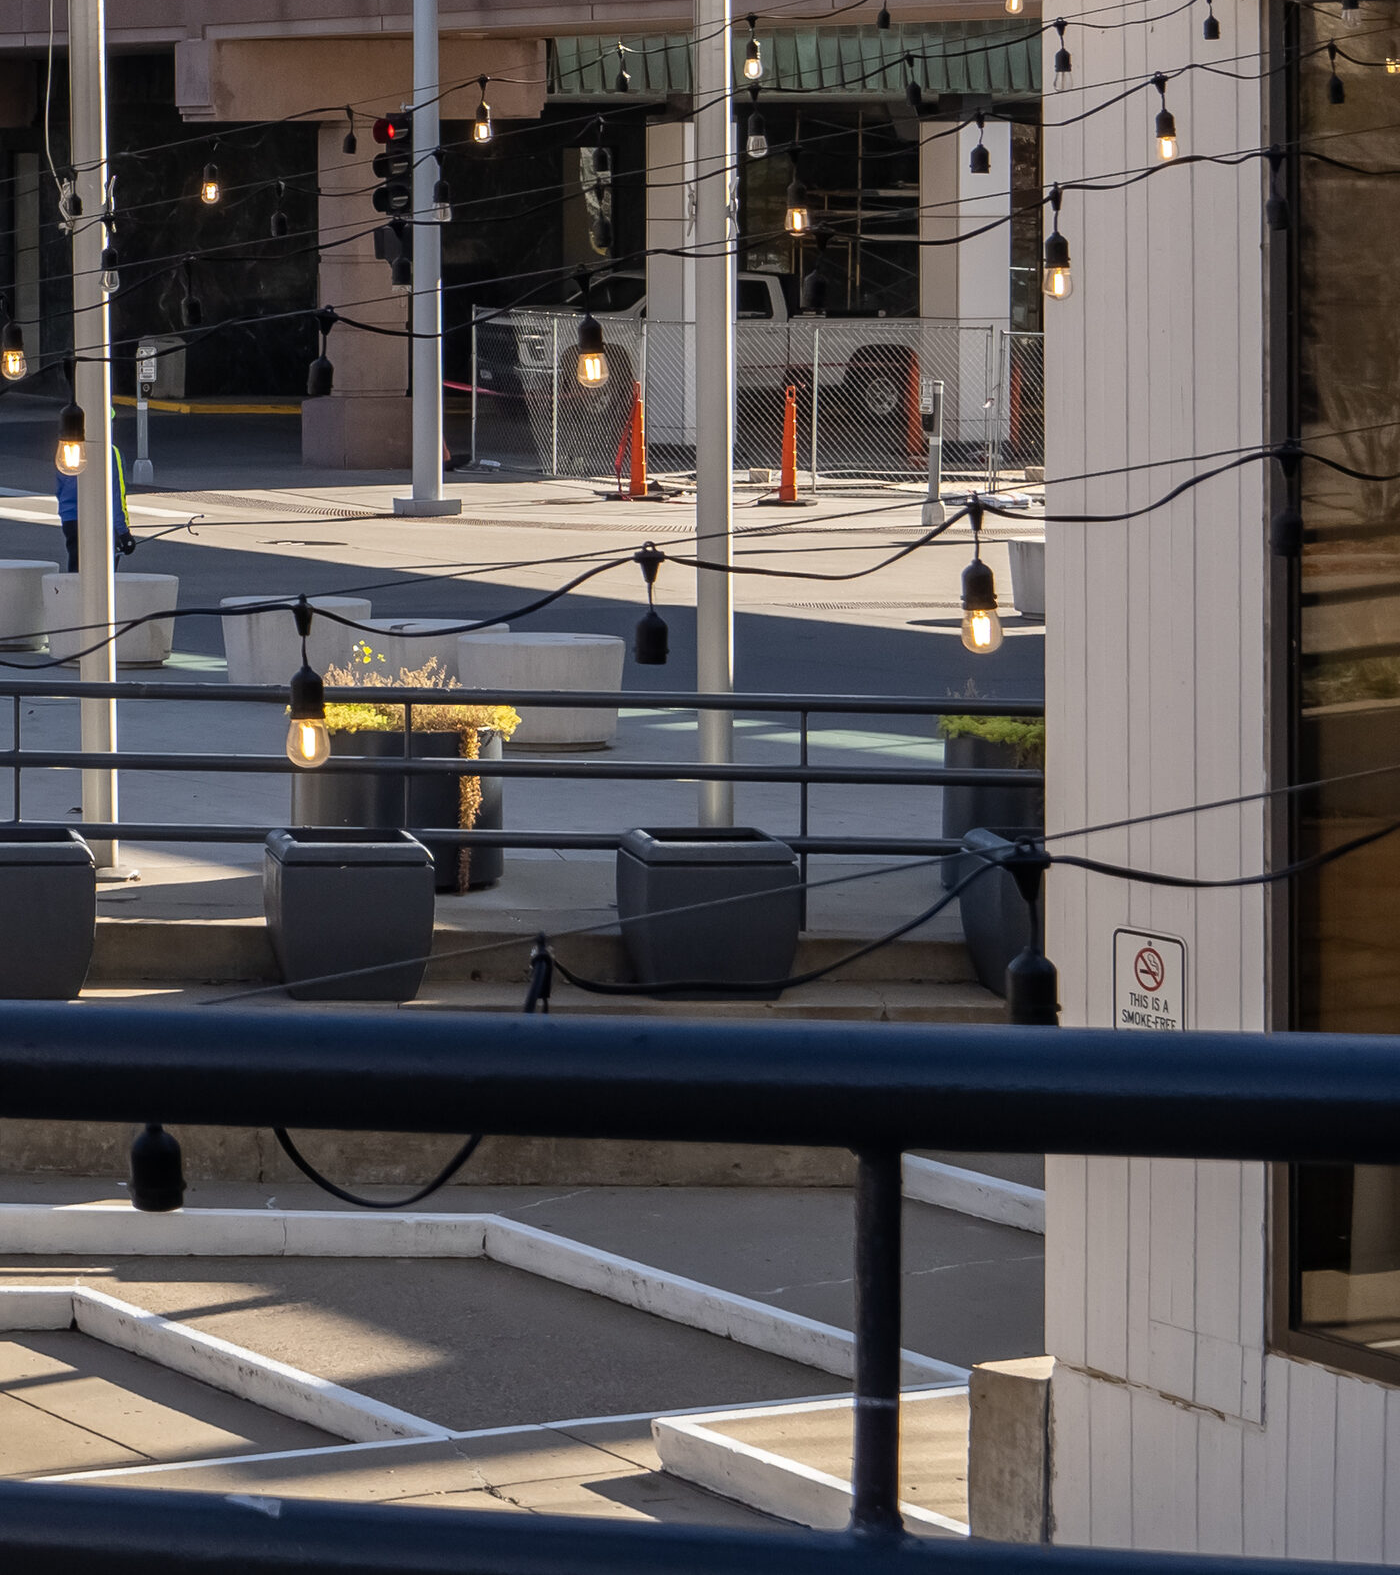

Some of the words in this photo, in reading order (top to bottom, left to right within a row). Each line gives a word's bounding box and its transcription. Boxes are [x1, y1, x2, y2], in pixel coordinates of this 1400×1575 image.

[1129, 992, 1148, 1009] THIS
[1152, 996, 1160, 1012] IS
[1163, 999, 1169, 1014] A
[1122, 1009, 1176, 1031] SMOKE-FREE
